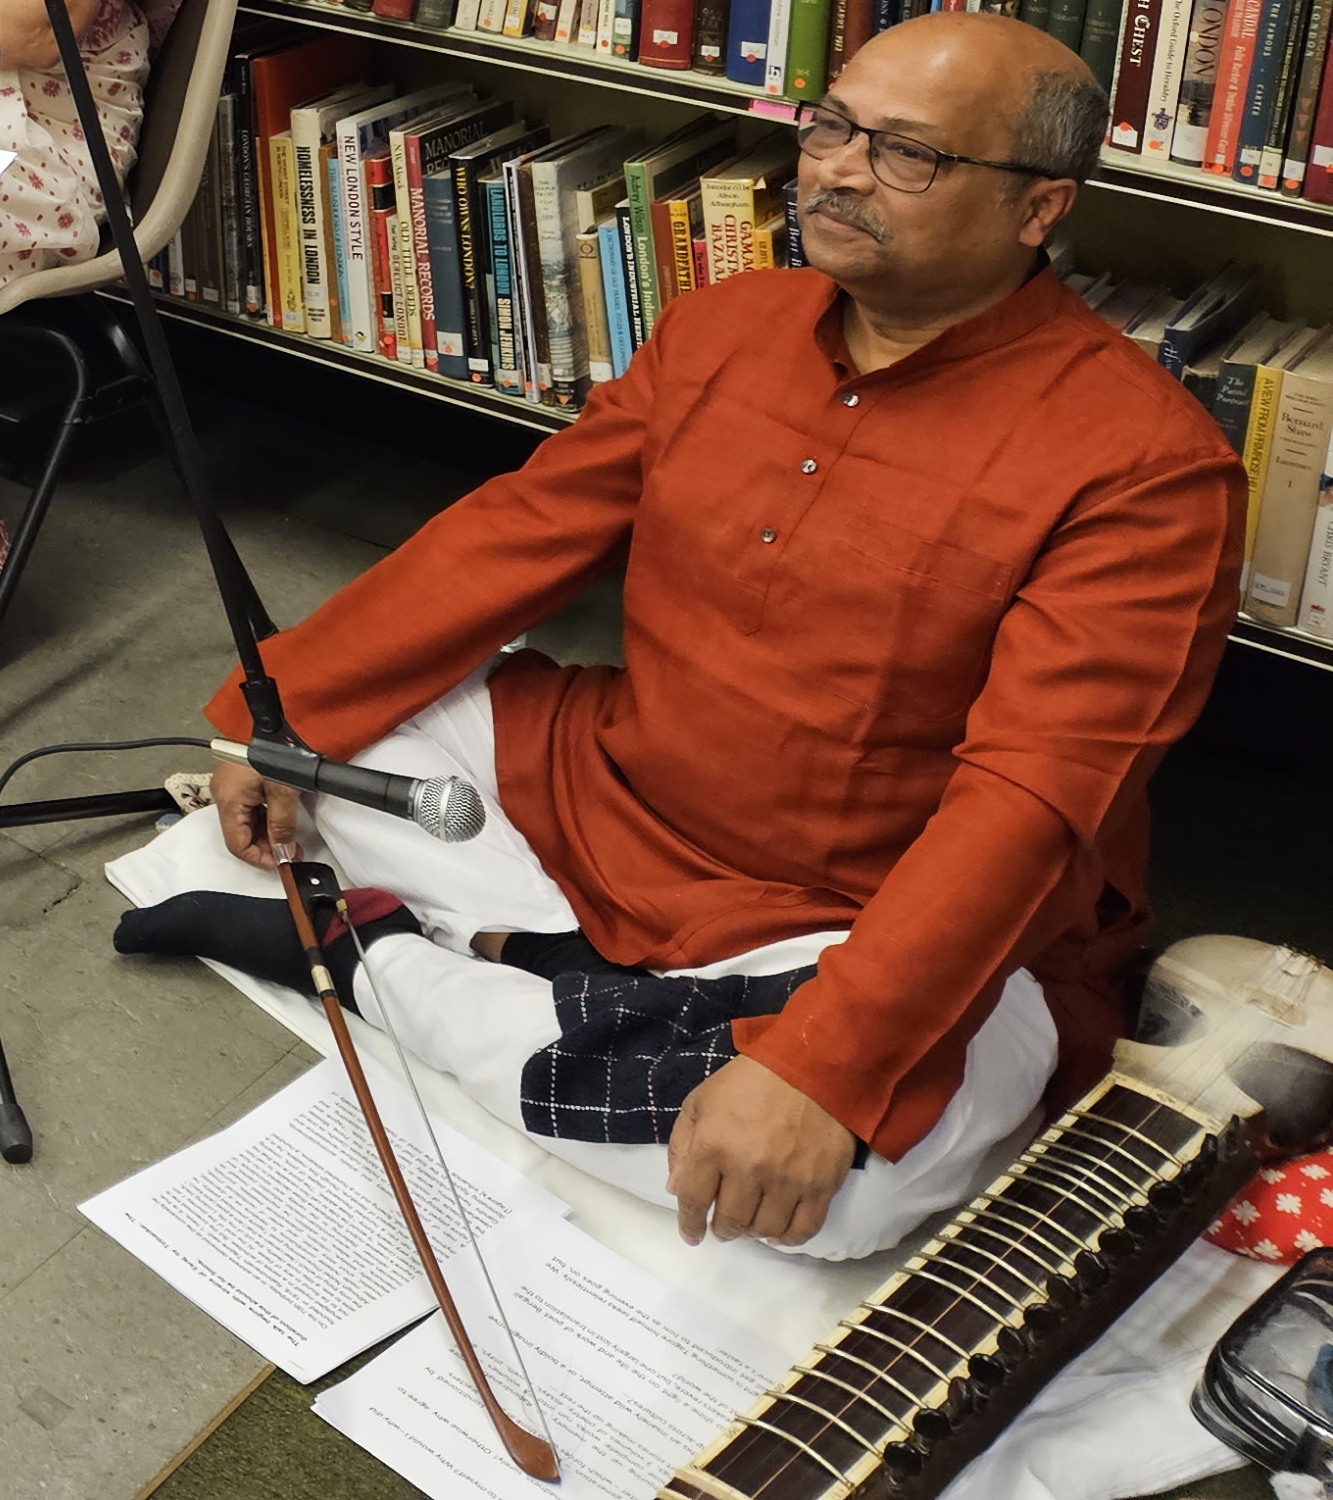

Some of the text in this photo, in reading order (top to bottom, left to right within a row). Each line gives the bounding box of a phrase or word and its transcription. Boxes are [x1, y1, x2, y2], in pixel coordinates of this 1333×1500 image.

[1129, 14, 1151, 67] CHEST
[298, 146, 319, 284] HOMELESSNESS IN LONDON
[345, 136, 362, 260] NEW LONDON STYLE
[457, 168, 474, 289] WHO OWNS LONDON?
[492, 189, 508, 295] LANDLORDS TO LONDON
[412, 188, 435, 321] MANORIAL RECORDS
[499, 298, 514, 370] SIMON JENKINS
[545, 1262, 689, 1356] Tagore himself seeks relentlessly. We
[551, 1256, 651, 1320] the evening goes on, but
[397, 1386, 491, 1454] Otherwise why agree to
